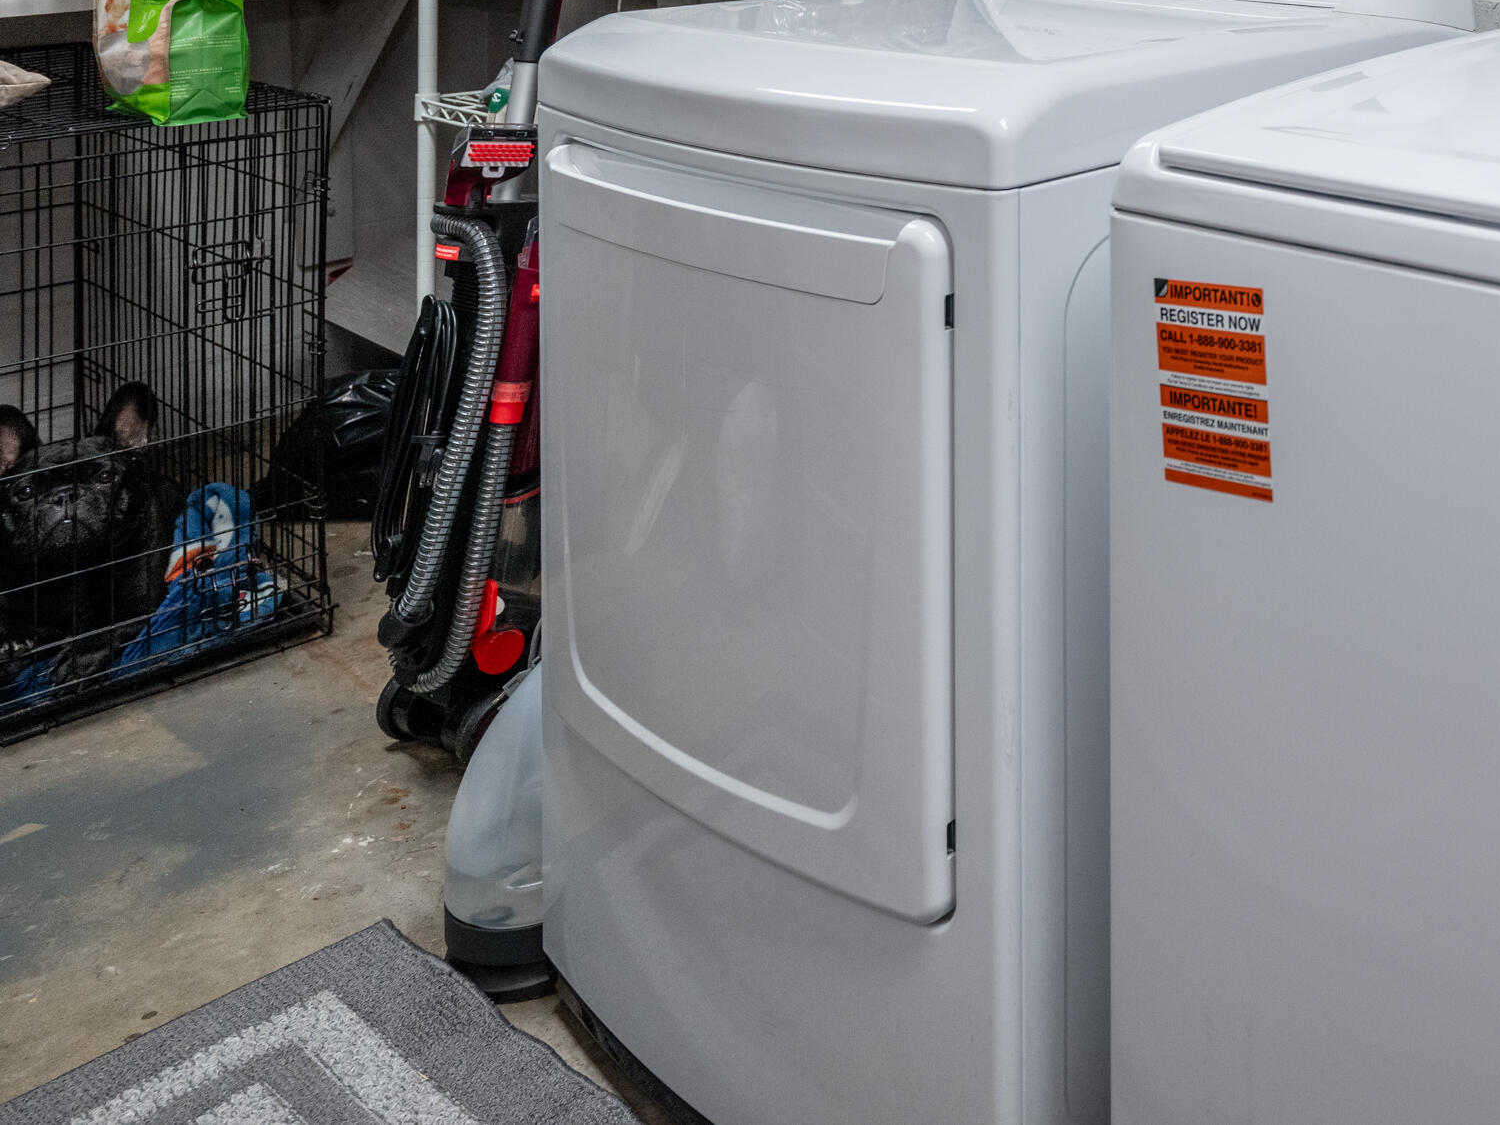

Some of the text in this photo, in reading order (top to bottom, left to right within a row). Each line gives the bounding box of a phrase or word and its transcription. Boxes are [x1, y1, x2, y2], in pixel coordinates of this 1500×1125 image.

[1170, 284, 1250, 307] IMPORTANT!
[1160, 307, 1261, 332] REGISTER NOW
[1160, 329, 1262, 354] CALL 1-888-900-3381
[1219, 354, 1234, 362] YOUR
[1236, 356, 1263, 365] PRODUCT
[1170, 391, 1258, 419] IMPORTANTE!
[1163, 410, 1269, 436] ENREGISTREZ MAINTENANT
[1166, 427, 1267, 453] APPELEZ LE 1-888-900-3381
